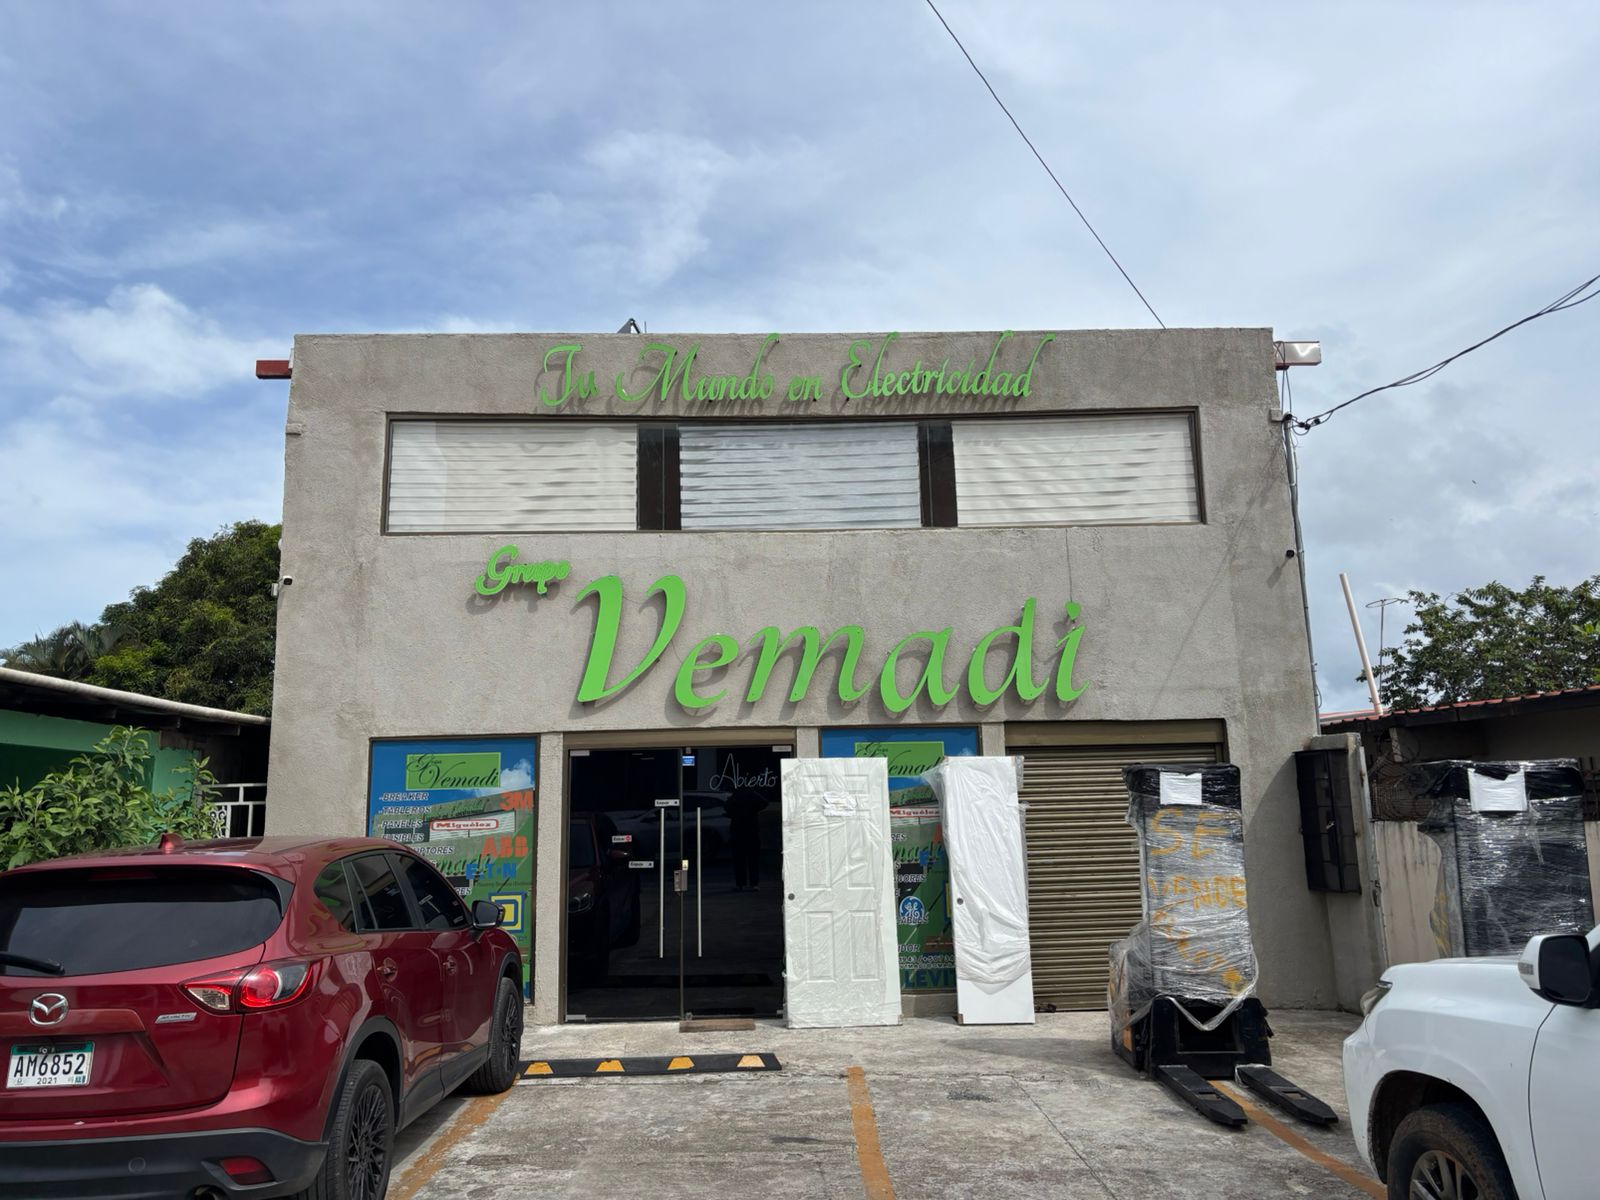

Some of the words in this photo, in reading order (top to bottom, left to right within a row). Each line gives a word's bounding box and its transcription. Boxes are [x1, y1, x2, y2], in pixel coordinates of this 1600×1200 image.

[541, 344, 598, 406] Tu
[616, 333, 780, 401] Mundo
[788, 369, 823, 401] en
[842, 330, 1056, 399] Electricidad
[474, 543, 571, 595] Grupo
[576, 575, 1090, 713] Vemadi
[418, 762, 499, 789] Vemadi
[710, 753, 778, 790] Abierto
[500, 792, 532, 811] 3M
[482, 836, 528, 858] ABB
[13, 1053, 86, 1078] AM6852
[37, 1077, 58, 1085] 2021
